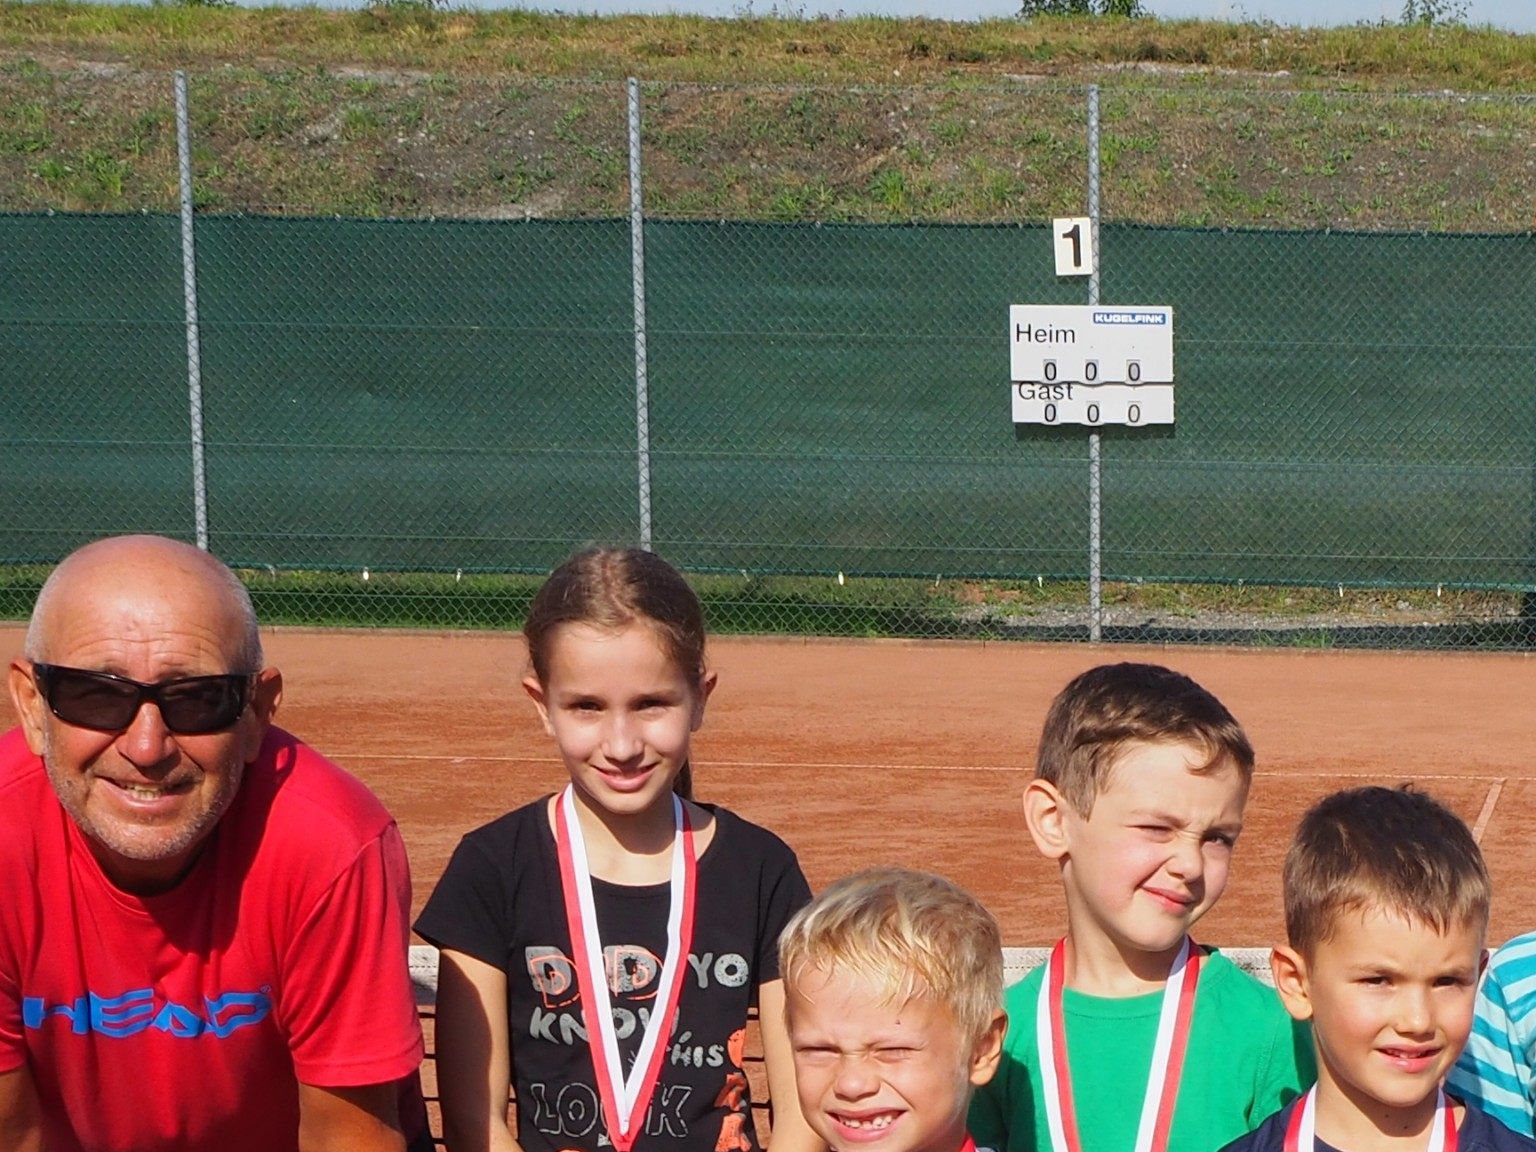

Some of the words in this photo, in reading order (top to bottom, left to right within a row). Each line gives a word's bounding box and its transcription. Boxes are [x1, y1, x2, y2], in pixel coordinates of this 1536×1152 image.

[1061, 224, 1082, 268] 1
[1094, 313, 1164, 324] KUGELFINK
[1015, 323, 1076, 344] Heim
[1044, 361, 1058, 382] 0
[1085, 361, 1098, 381] 0
[1128, 362, 1141, 382] 0
[1017, 381, 1074, 401] Gast
[1044, 403, 1057, 423] 0
[1086, 403, 1100, 424] 0
[1127, 404, 1141, 423] 0
[22, 987, 273, 1039] HEAD
[530, 1081, 693, 1138] LOK
